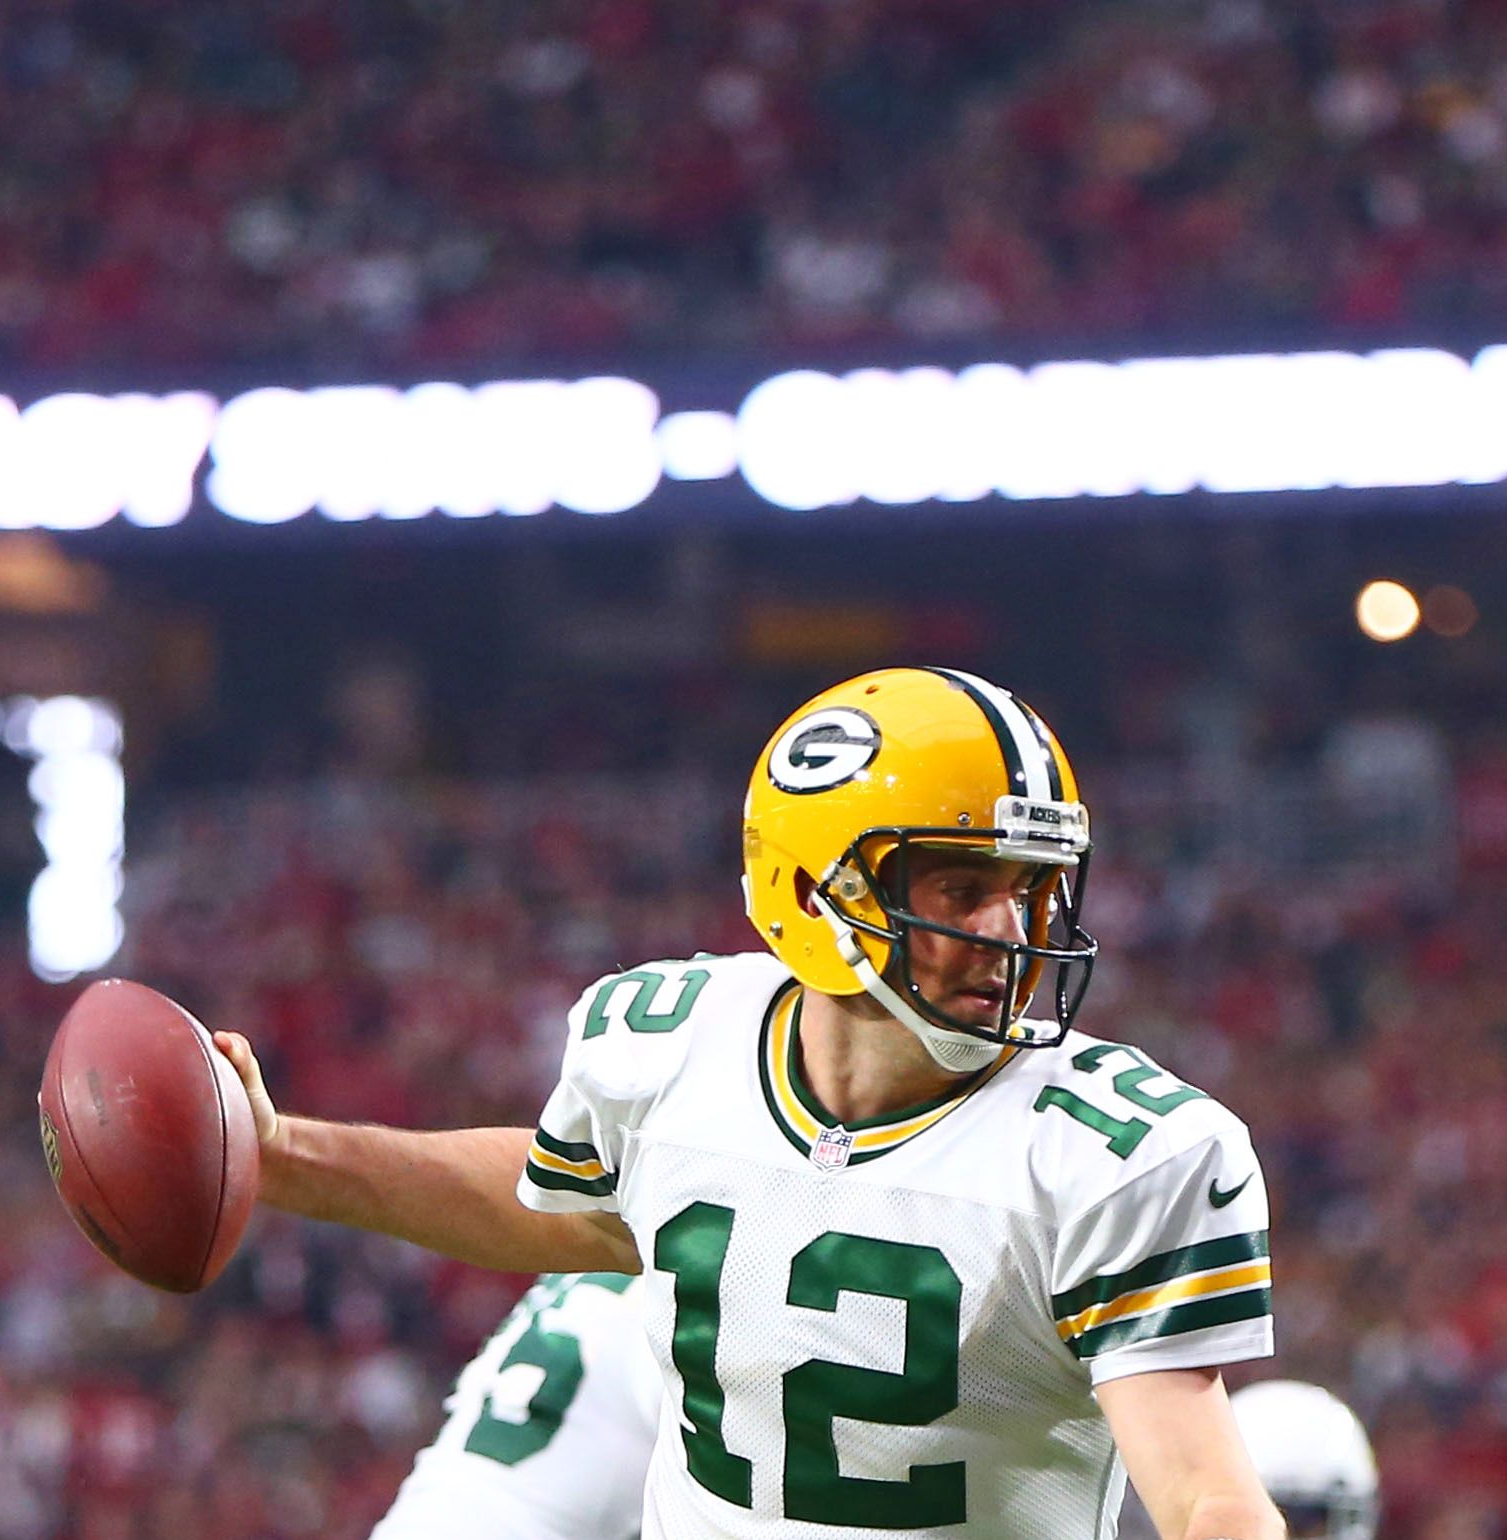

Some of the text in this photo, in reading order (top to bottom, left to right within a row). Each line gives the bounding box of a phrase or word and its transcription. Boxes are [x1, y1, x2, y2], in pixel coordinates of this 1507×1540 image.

[768, 706, 881, 793] G
[582, 967, 713, 1041] 2
[1033, 1044, 1209, 1161] 12
[654, 1200, 968, 1530] 12
